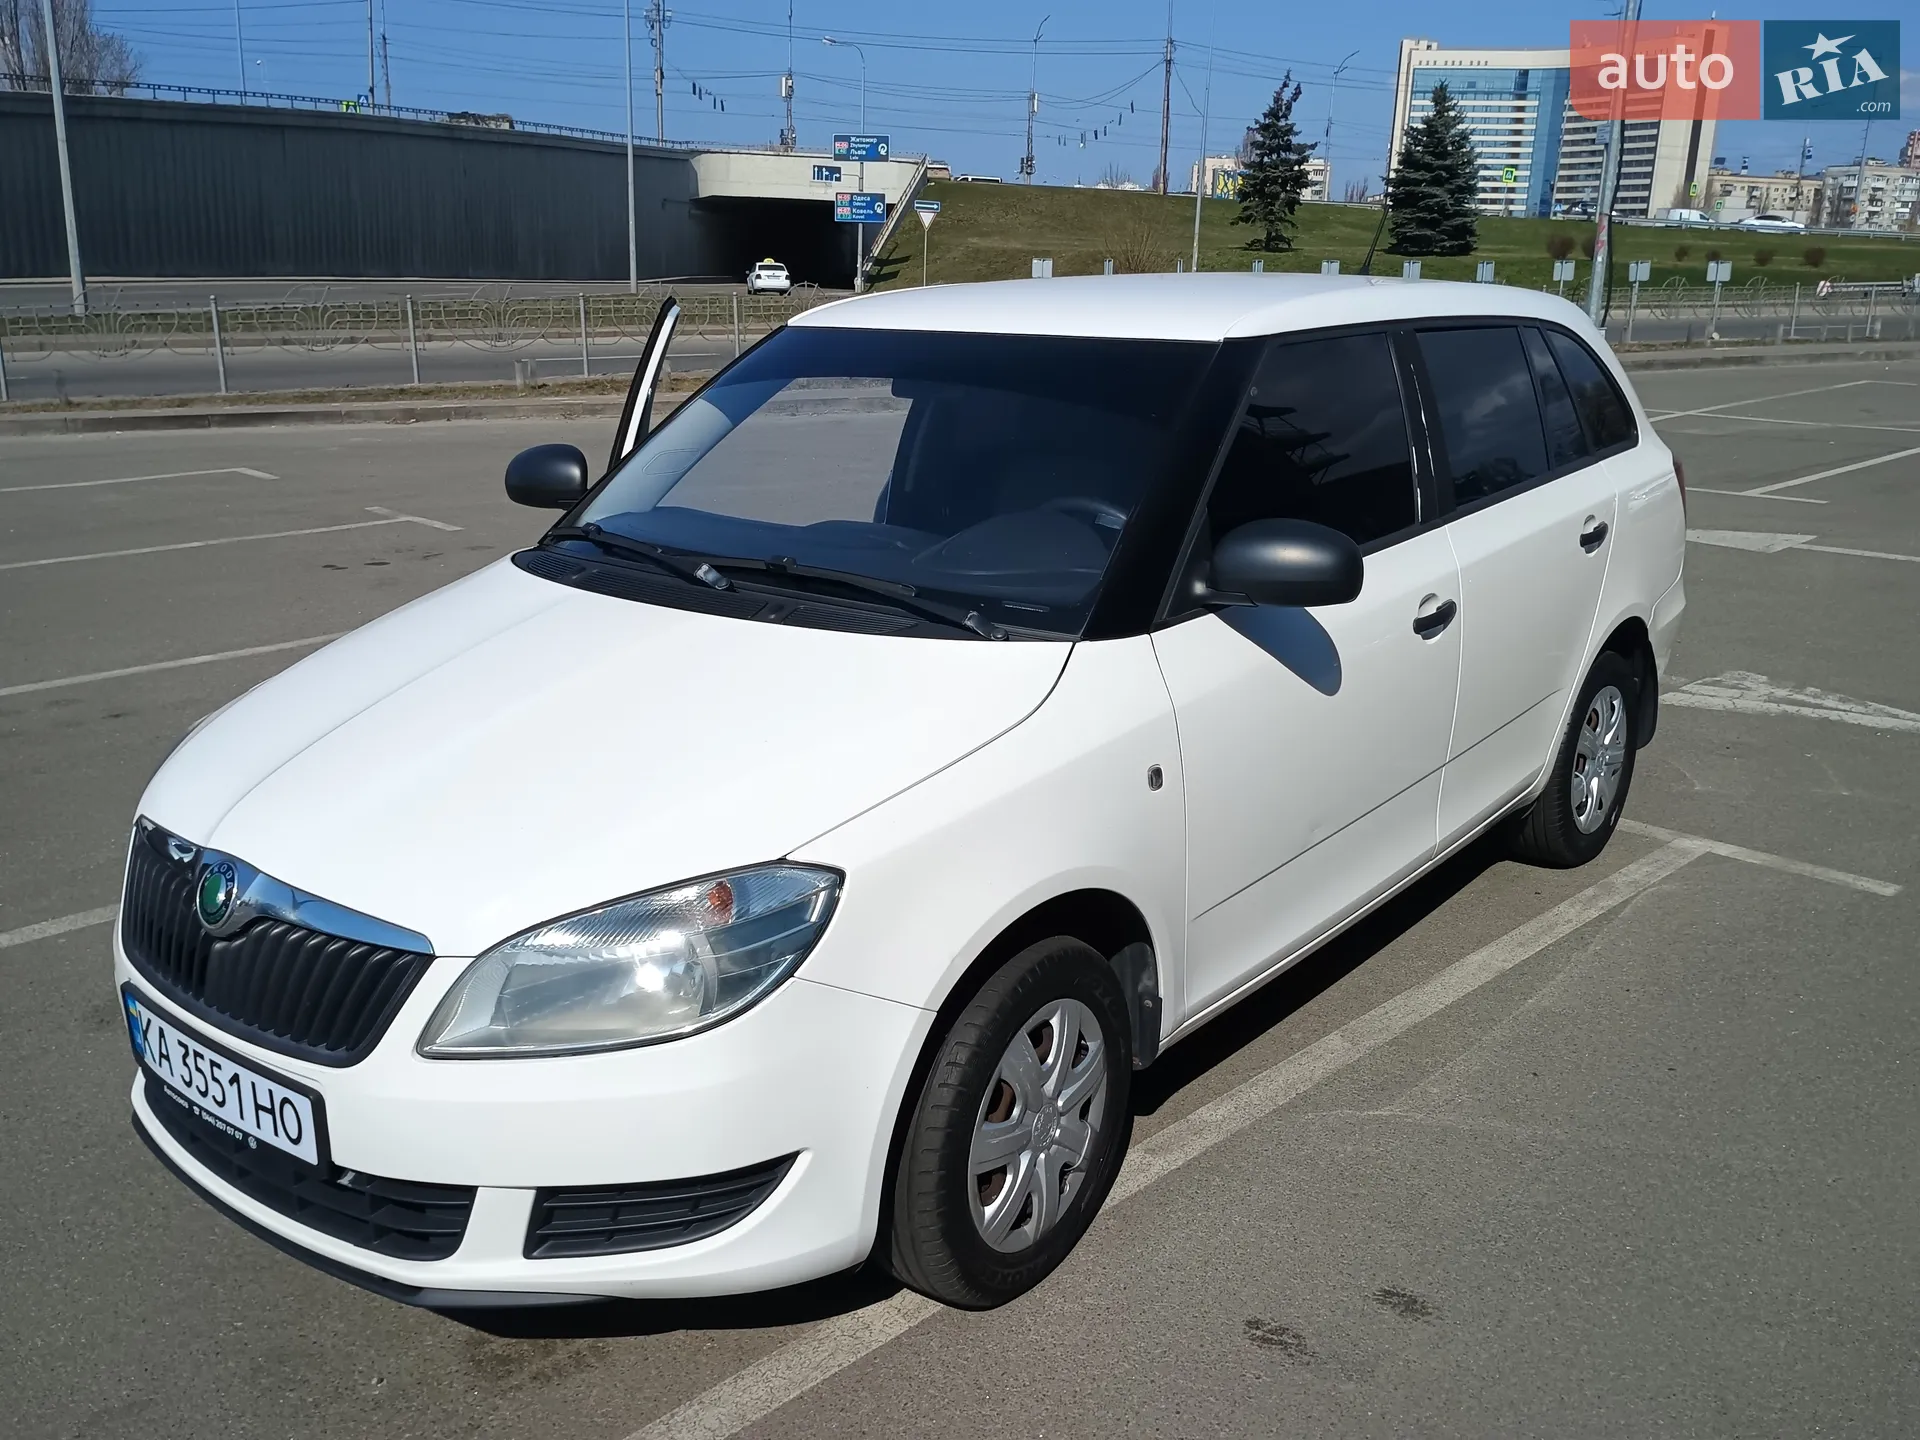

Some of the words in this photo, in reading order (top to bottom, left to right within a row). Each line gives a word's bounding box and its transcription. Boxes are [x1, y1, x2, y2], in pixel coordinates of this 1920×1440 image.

[138, 1010, 174, 1078] KA
[177, 1039, 244, 1120] 3551
[251, 1081, 303, 1146] HO
